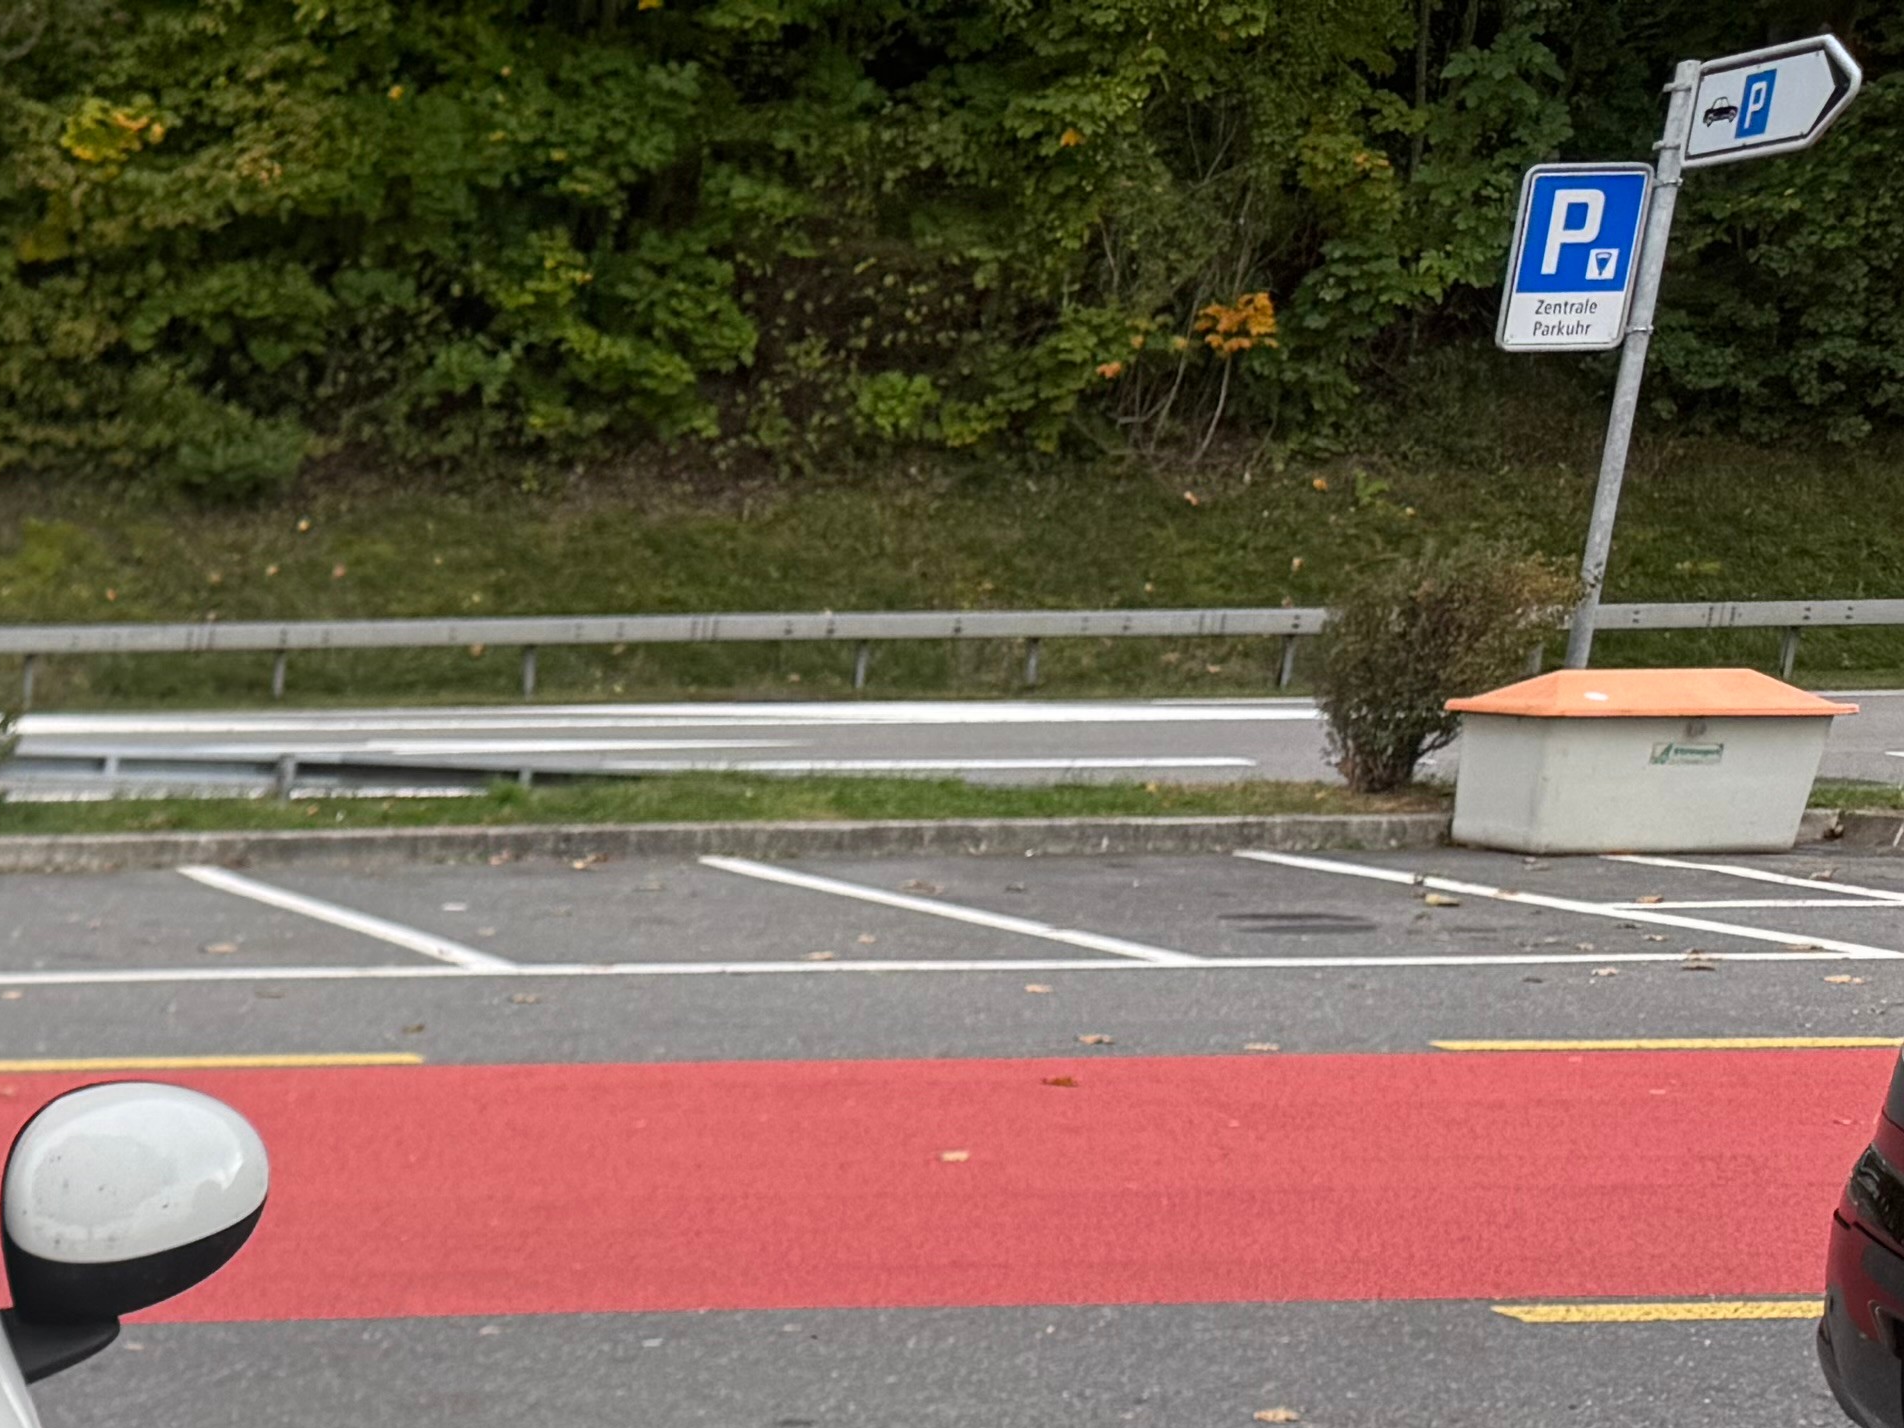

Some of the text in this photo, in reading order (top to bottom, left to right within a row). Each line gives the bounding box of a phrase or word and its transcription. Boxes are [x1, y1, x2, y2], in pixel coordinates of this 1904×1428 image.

[1743, 81, 1767, 129] P
[1541, 189, 1605, 275] P
[1535, 298, 1598, 315] Zentrale
[1533, 320, 1592, 336] Parkuhr
